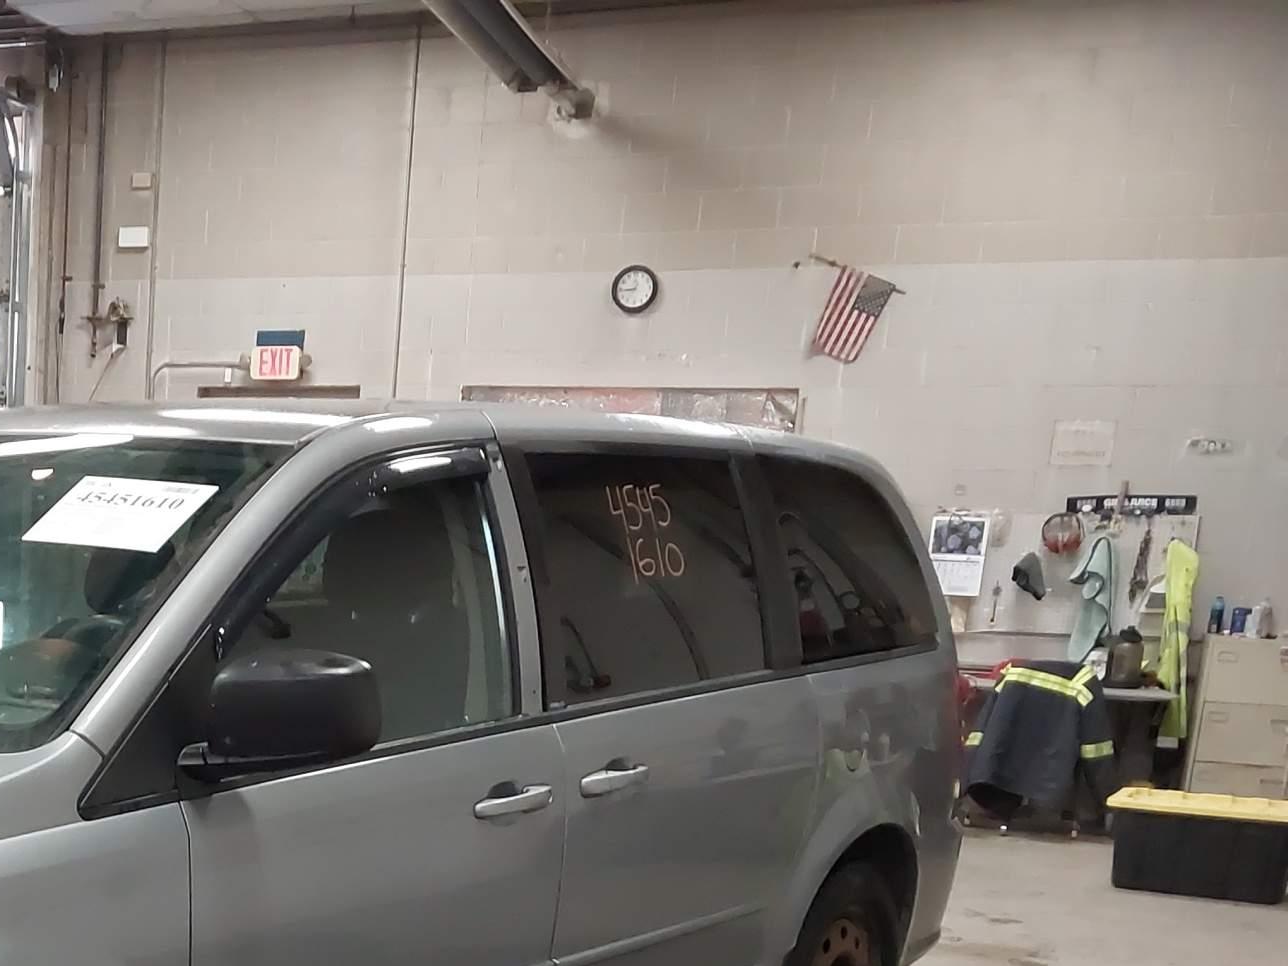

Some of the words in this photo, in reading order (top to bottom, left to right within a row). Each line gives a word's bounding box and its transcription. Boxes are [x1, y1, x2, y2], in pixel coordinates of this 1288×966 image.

[259, 347, 294, 377] EXIT
[76, 490, 185, 510] 45451610
[605, 483, 671, 534] 4545
[626, 537, 685, 585] 1610
